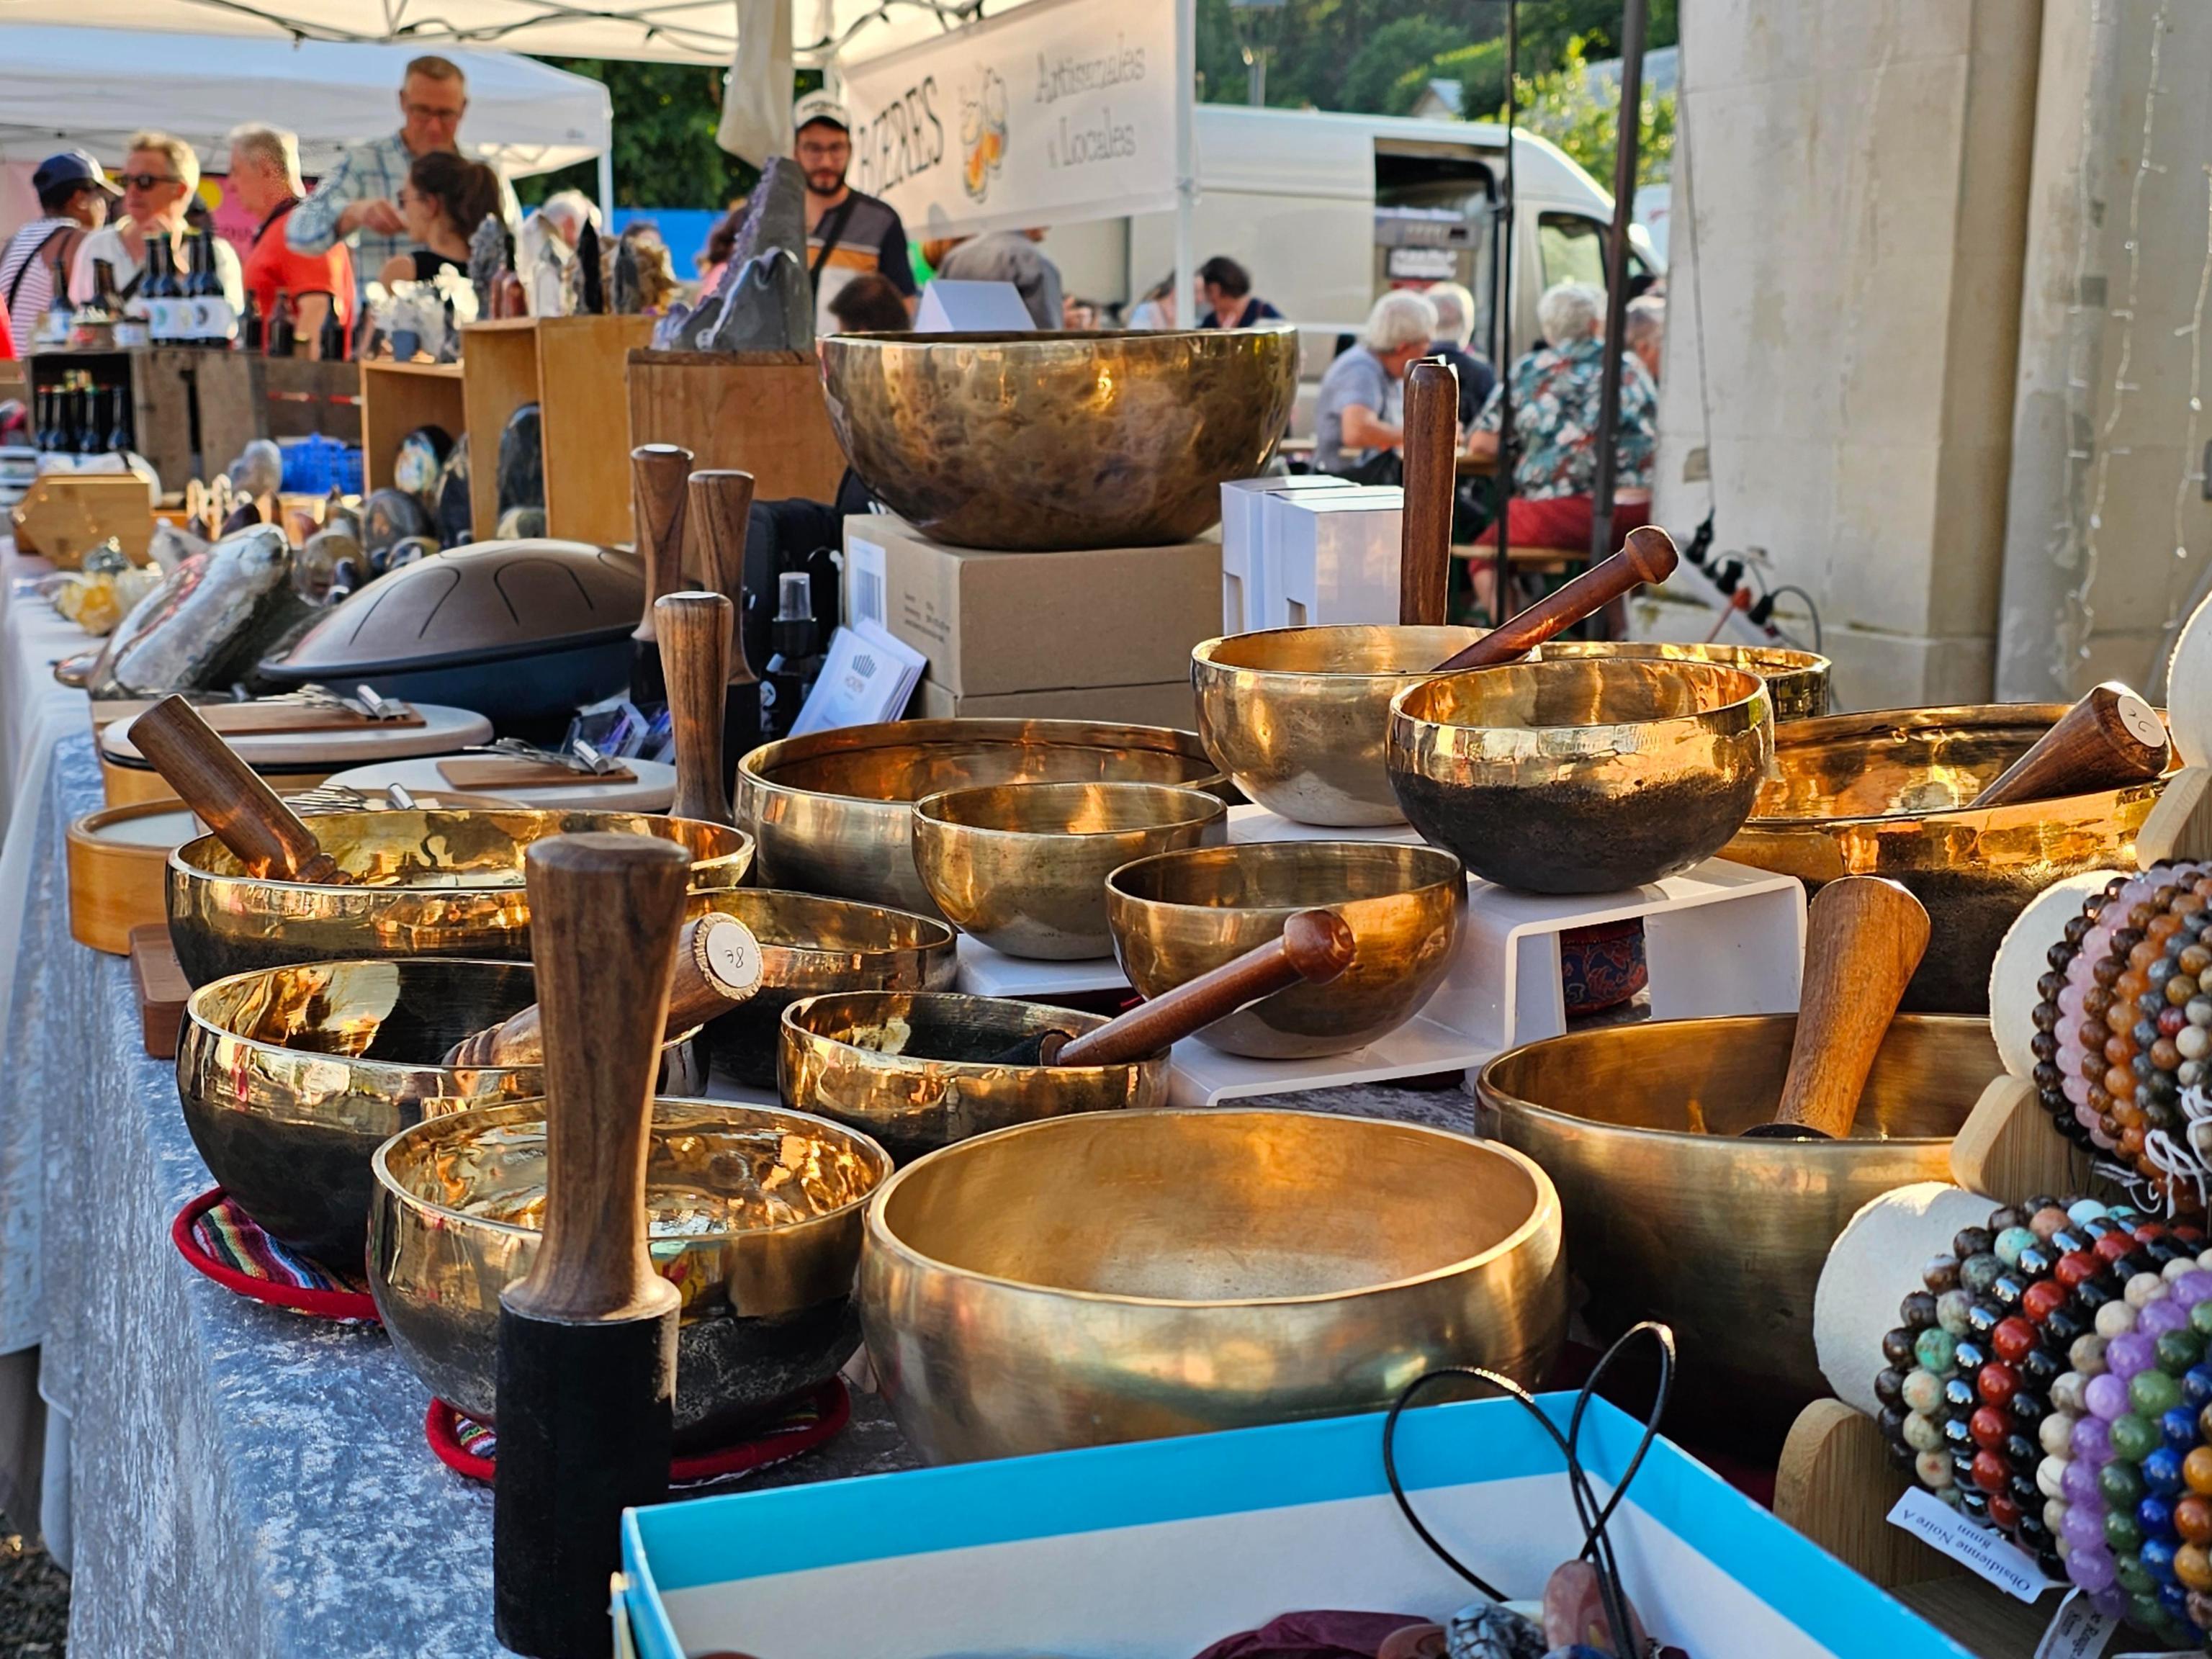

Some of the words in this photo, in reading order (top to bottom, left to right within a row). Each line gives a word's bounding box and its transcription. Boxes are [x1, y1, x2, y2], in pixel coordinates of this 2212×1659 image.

[1035, 32, 1146, 103] Artisanales
[1059, 108, 1136, 166] Locales
[1902, 1509, 1915, 1521] A
[1915, 1516, 1954, 1545] Noire
[1957, 1523, 1992, 1550] 8mm
[1954, 1541, 2031, 1591] Obsidienne
